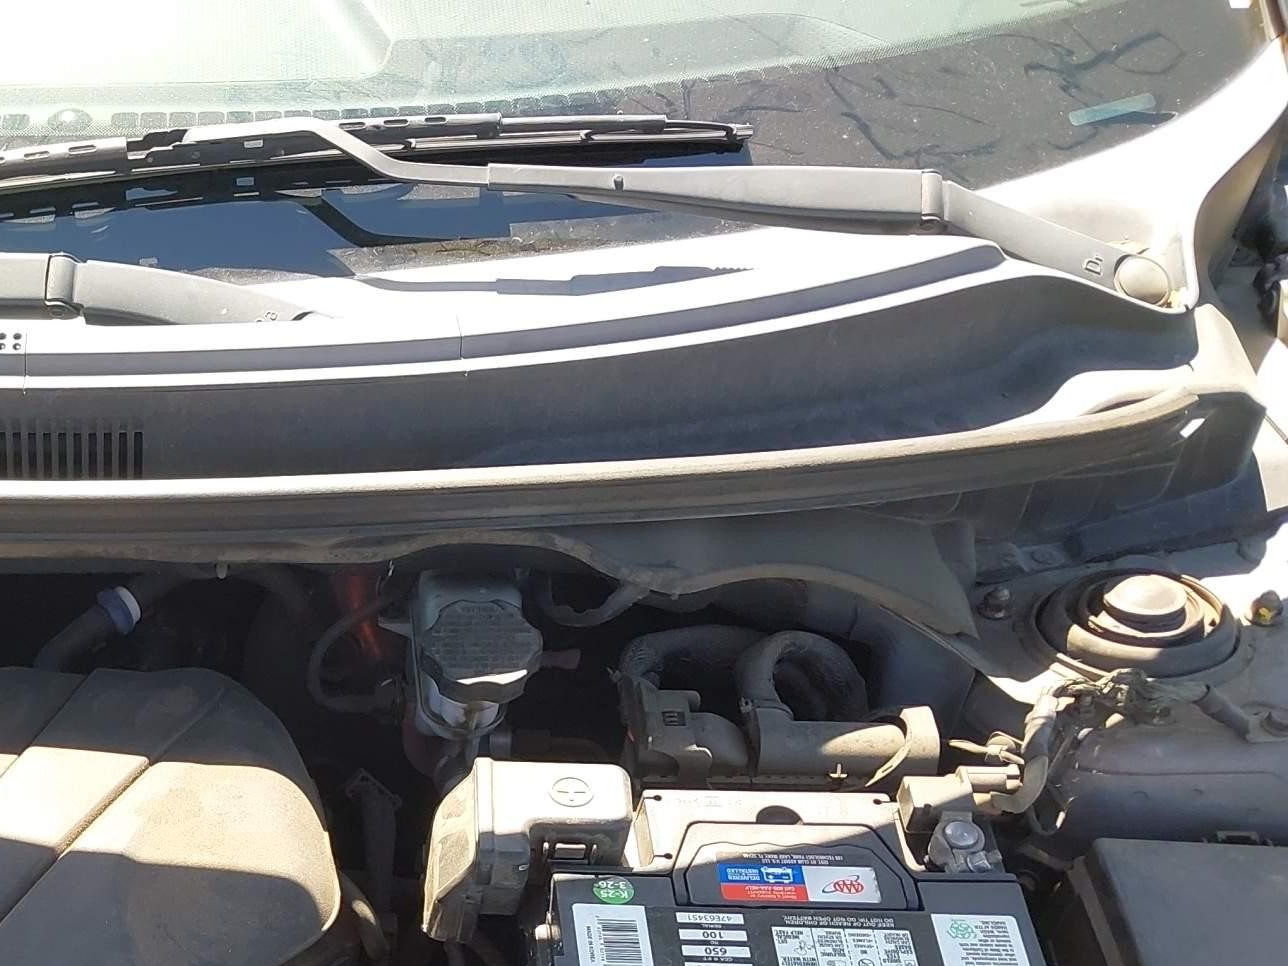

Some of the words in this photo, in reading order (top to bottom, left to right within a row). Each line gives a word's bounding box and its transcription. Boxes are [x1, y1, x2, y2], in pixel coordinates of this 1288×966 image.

[835, 880, 863, 893] AAA
[600, 890, 628, 898] K-25
[705, 947, 727, 955] 650
